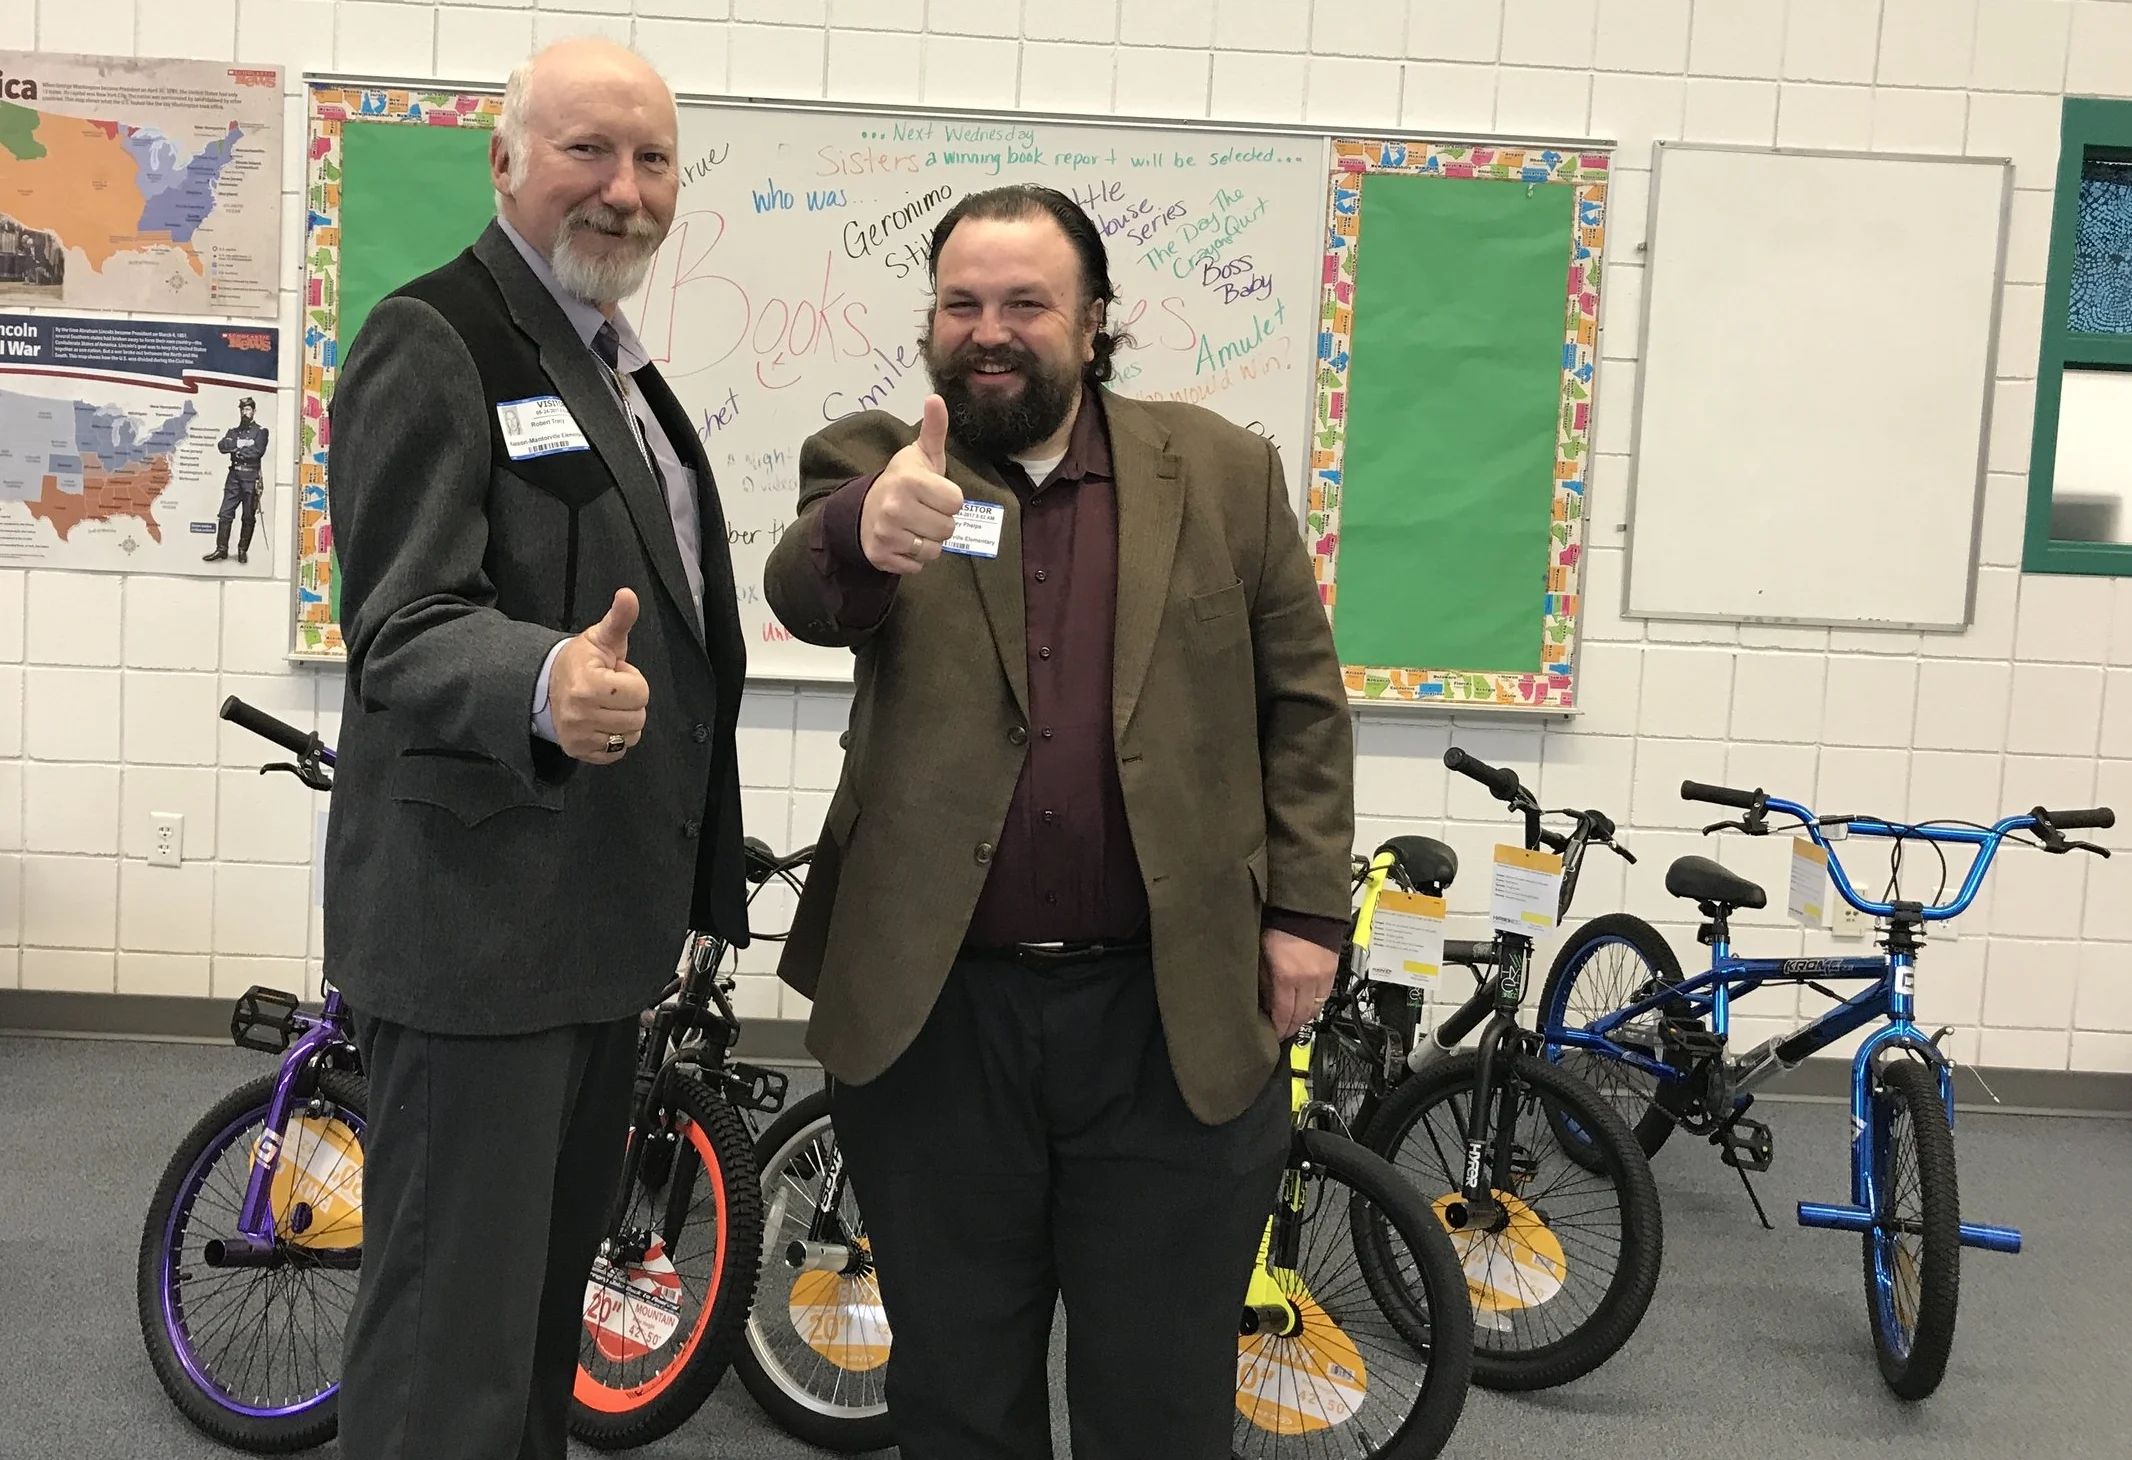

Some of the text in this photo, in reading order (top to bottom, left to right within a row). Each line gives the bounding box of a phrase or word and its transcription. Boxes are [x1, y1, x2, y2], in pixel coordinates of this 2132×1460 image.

[945, 124, 1034, 149] Wednesday
[680, 143, 730, 188] rue
[816, 145, 920, 176] Sisters
[925, 151, 937, 167] a
[943, 151, 1001, 175] winning
[1007, 150, 1047, 166] book
[1055, 148, 1117, 172] report
[1131, 152, 1163, 168] will
[1174, 151, 1196, 168] be
[843, 184, 953, 259] Geronimo
[1137, 188, 1245, 272] The Day The
[1224, 197, 1269, 238] Quit
[1195, 255, 1254, 287] Boss
[639, 210, 871, 378] Books
[1213, 275, 1274, 305] Baby
[0, 322, 38, 338] ncoln
[1196, 299, 1285, 376] Amulet
[7, 341, 42, 357] War
[530, 419, 551, 428] Robert
[698, 387, 740, 446] chet
[964, 504, 992, 514] SITOR
[728, 521, 762, 545] ber
[965, 536, 995, 546] Elementary
[635, 1303, 676, 1328] MOUNTAIN
